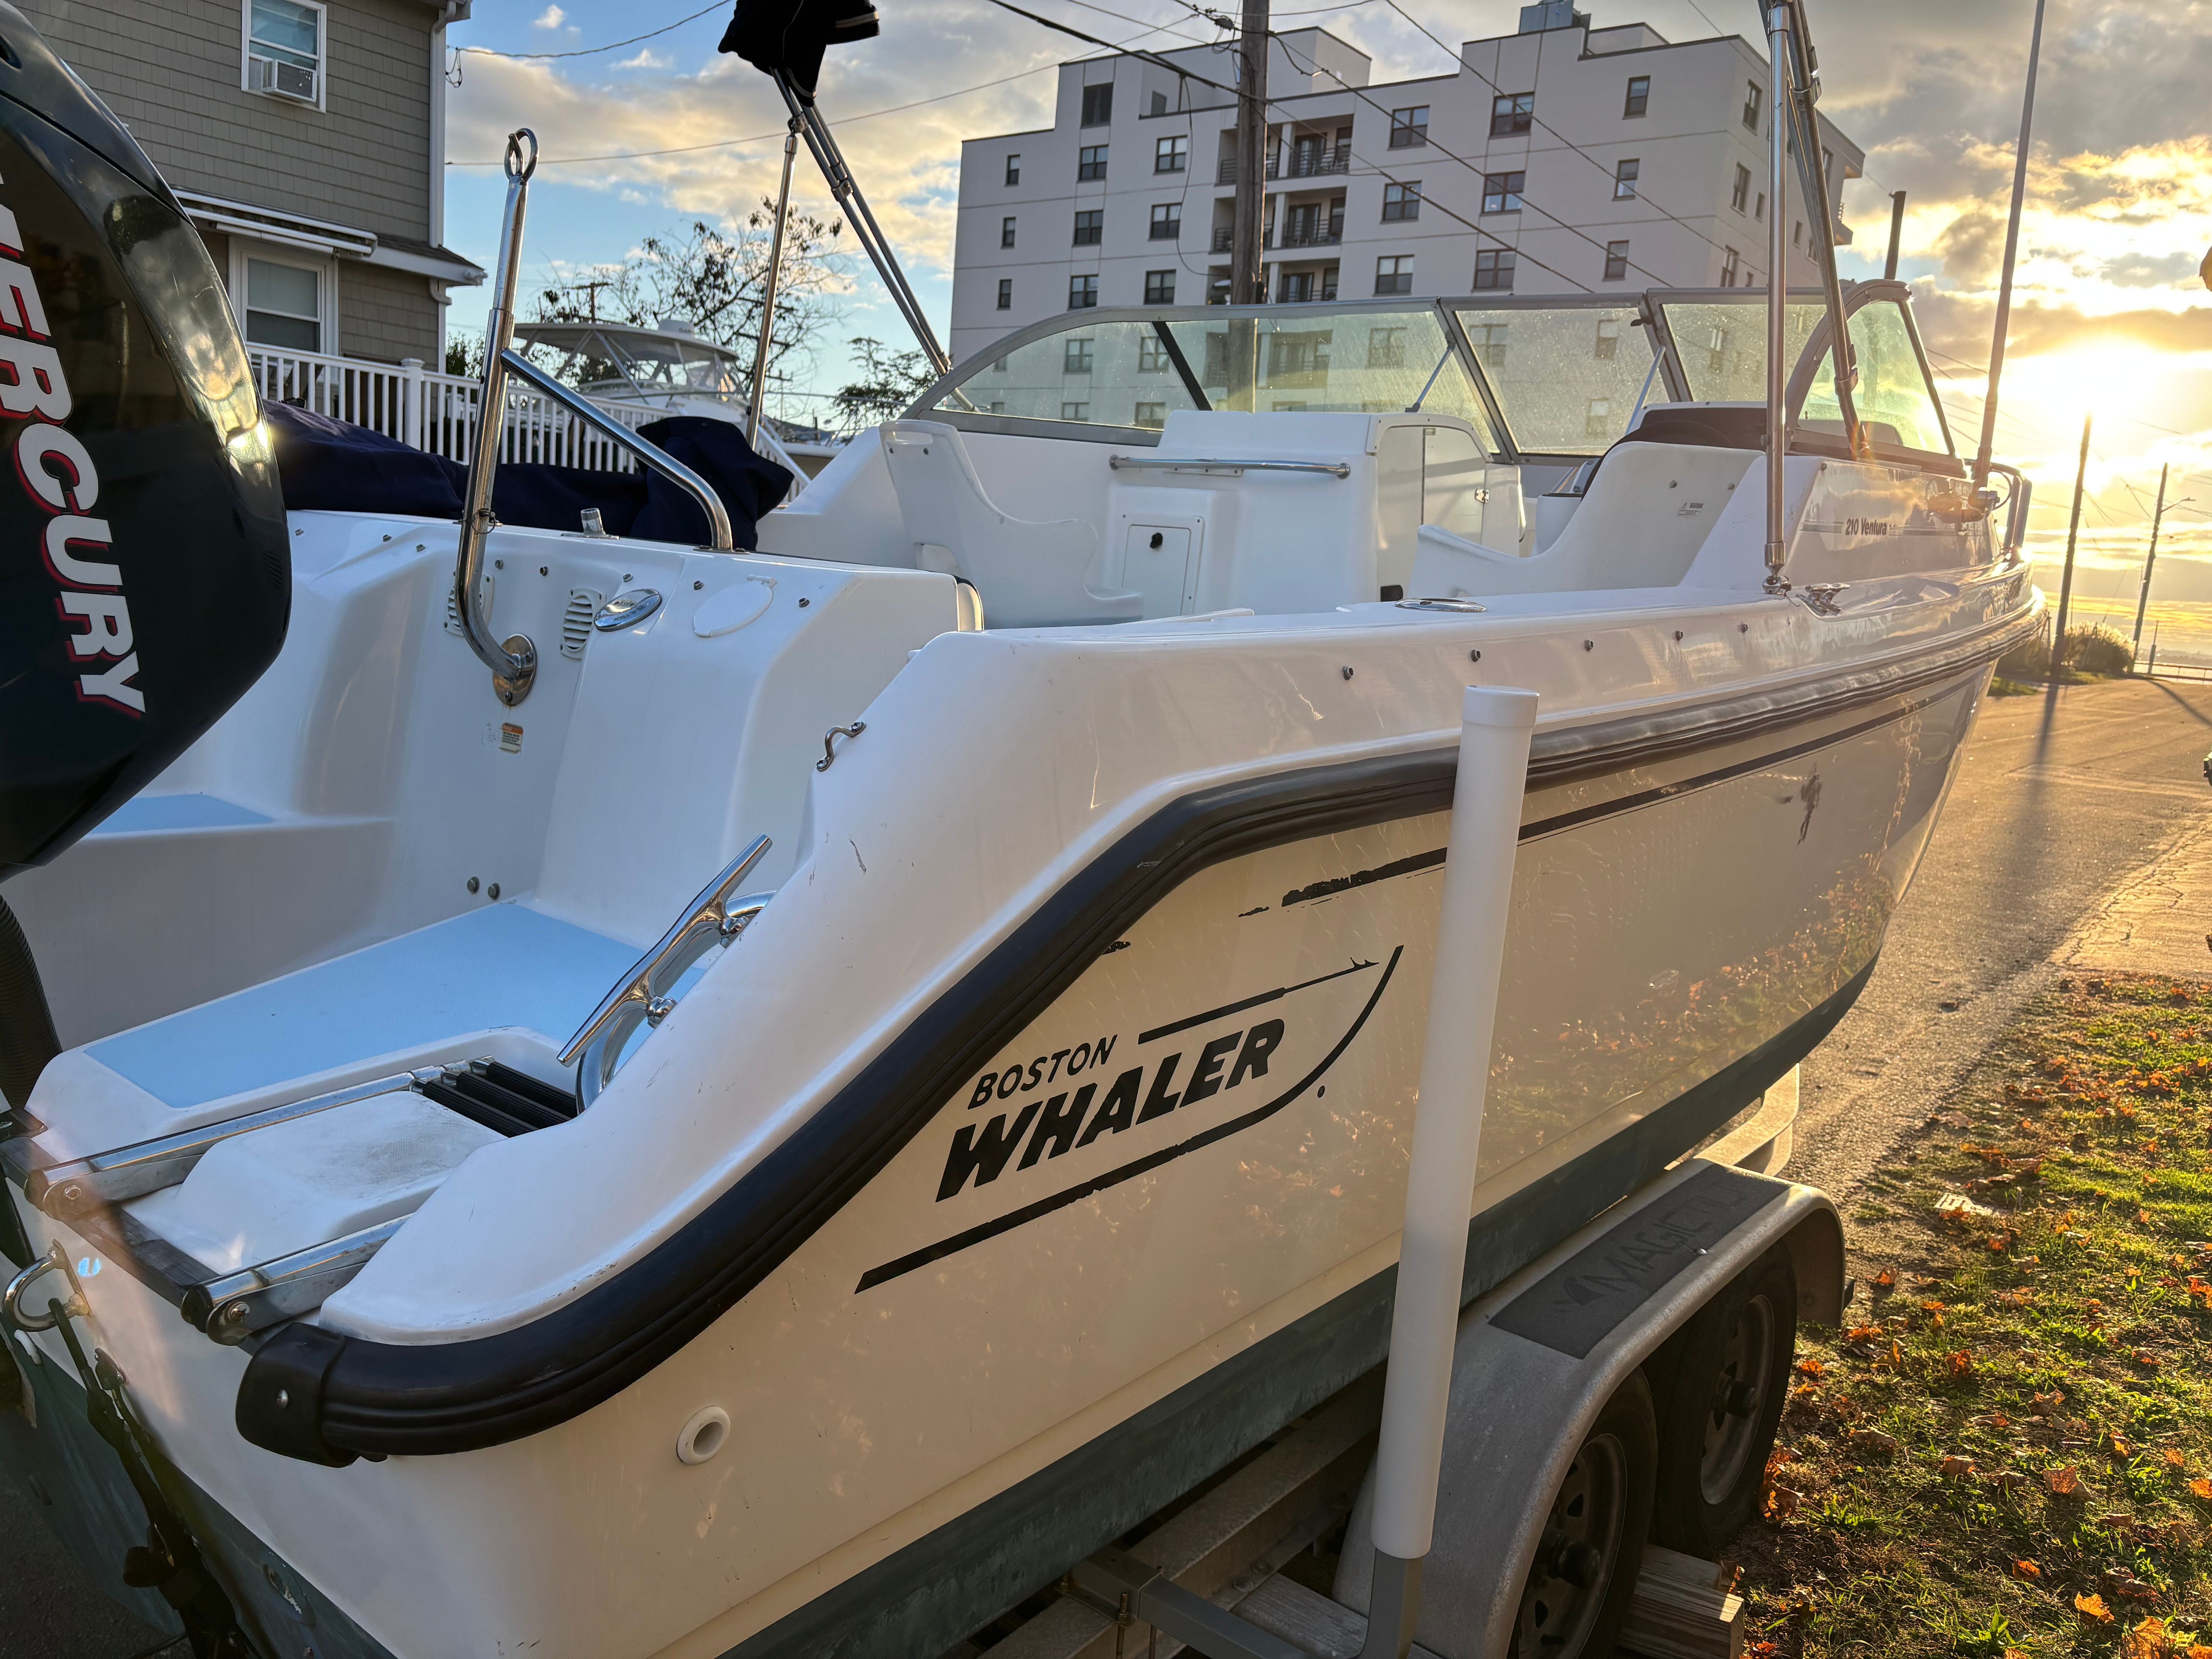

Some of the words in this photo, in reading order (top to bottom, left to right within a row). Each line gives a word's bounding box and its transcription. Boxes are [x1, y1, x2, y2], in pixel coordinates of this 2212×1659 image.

[0, 170, 146, 719] ERCURY
[1845, 518, 1859, 536] 210
[1861, 517, 1887, 536] Ventura
[935, 1018, 1285, 1203] WHALER
[968, 1034, 1118, 1110] BOSTON
